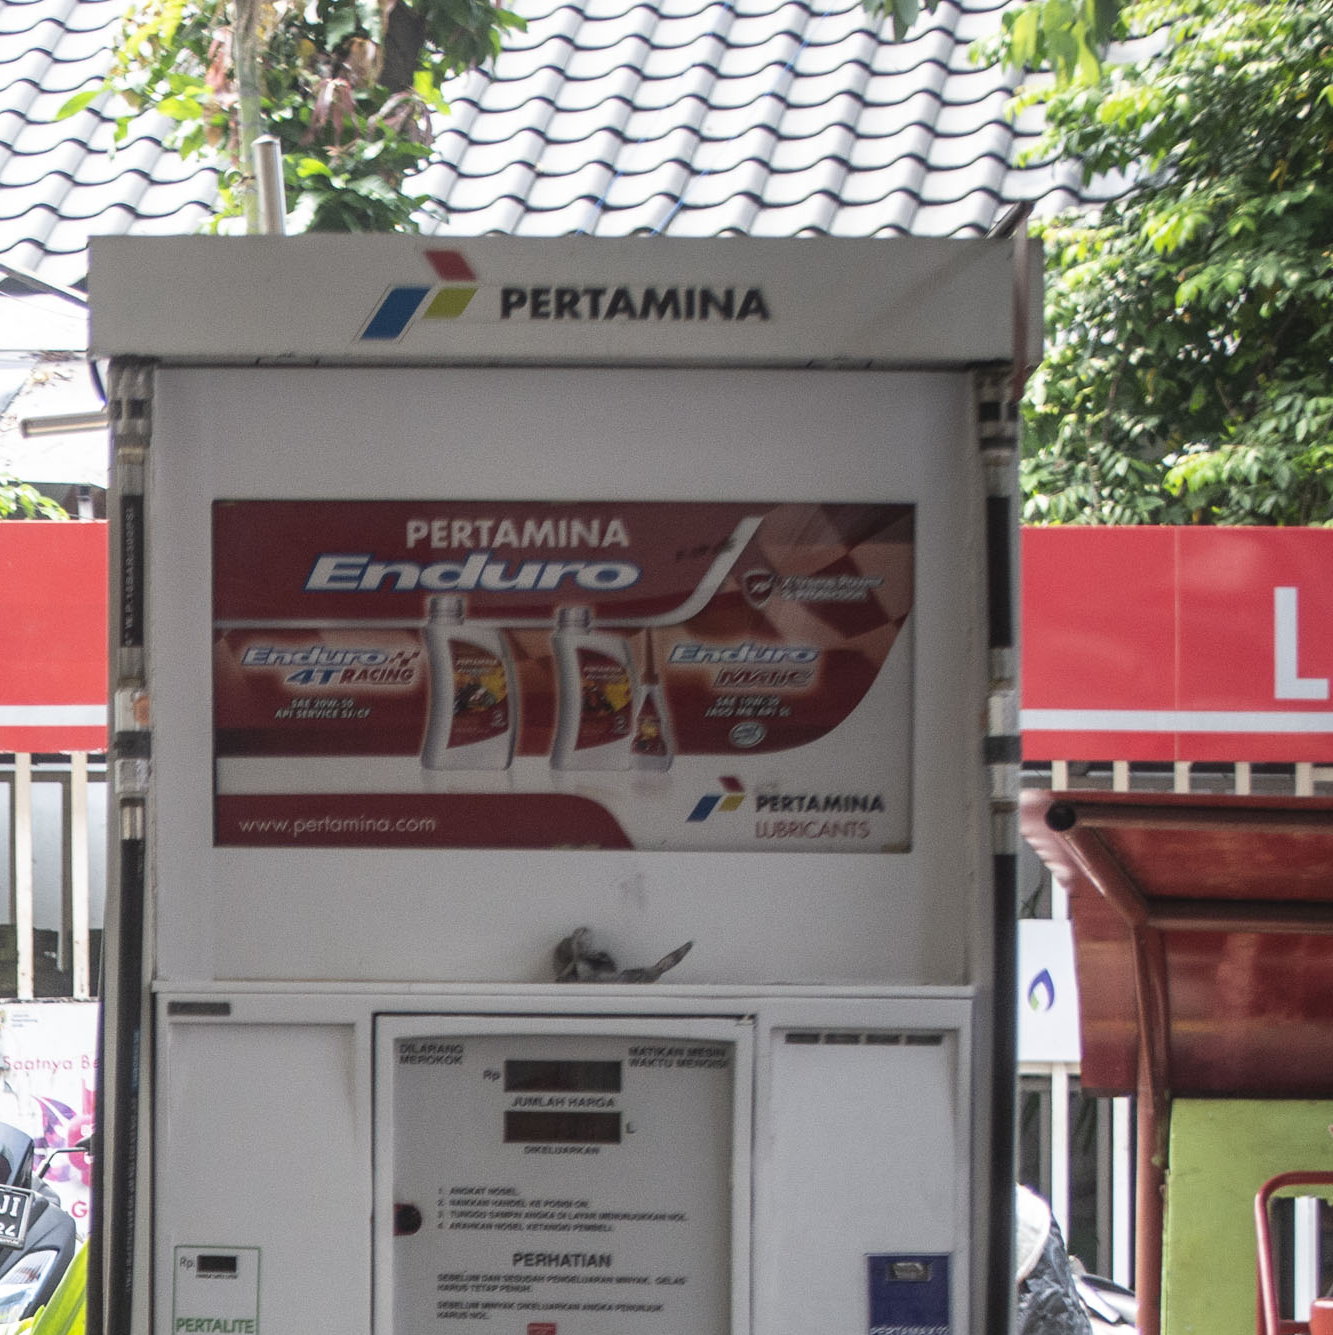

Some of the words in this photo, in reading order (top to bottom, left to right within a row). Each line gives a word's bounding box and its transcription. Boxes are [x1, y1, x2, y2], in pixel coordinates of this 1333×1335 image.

[501, 287, 771, 321] PERTAMINA
[406, 518, 630, 549] PERTAMINA
[302, 549, 642, 593] Enduro
[1274, 587, 1330, 700] L
[242, 644, 391, 667] Enduro
[669, 644, 821, 664] Enduro
[284, 668, 340, 685] 4T
[338, 668, 415, 685] RACING
[755, 795, 885, 813] PERTAMINA
[238, 815, 437, 838] www.pertamina.com
[755, 821, 872, 839] LUBRICANTS
[399, 1044, 464, 1054] DILARANG
[2, 1055, 73, 1075] Saatnya
[483, 1069, 501, 1082] Rp
[512, 1097, 565, 1108] JUMLAH
[567, 1097, 614, 1108] HARGA
[512, 1252, 613, 1268] PERHATIAN
[176, 1317, 255, 1334] PERTALITE
